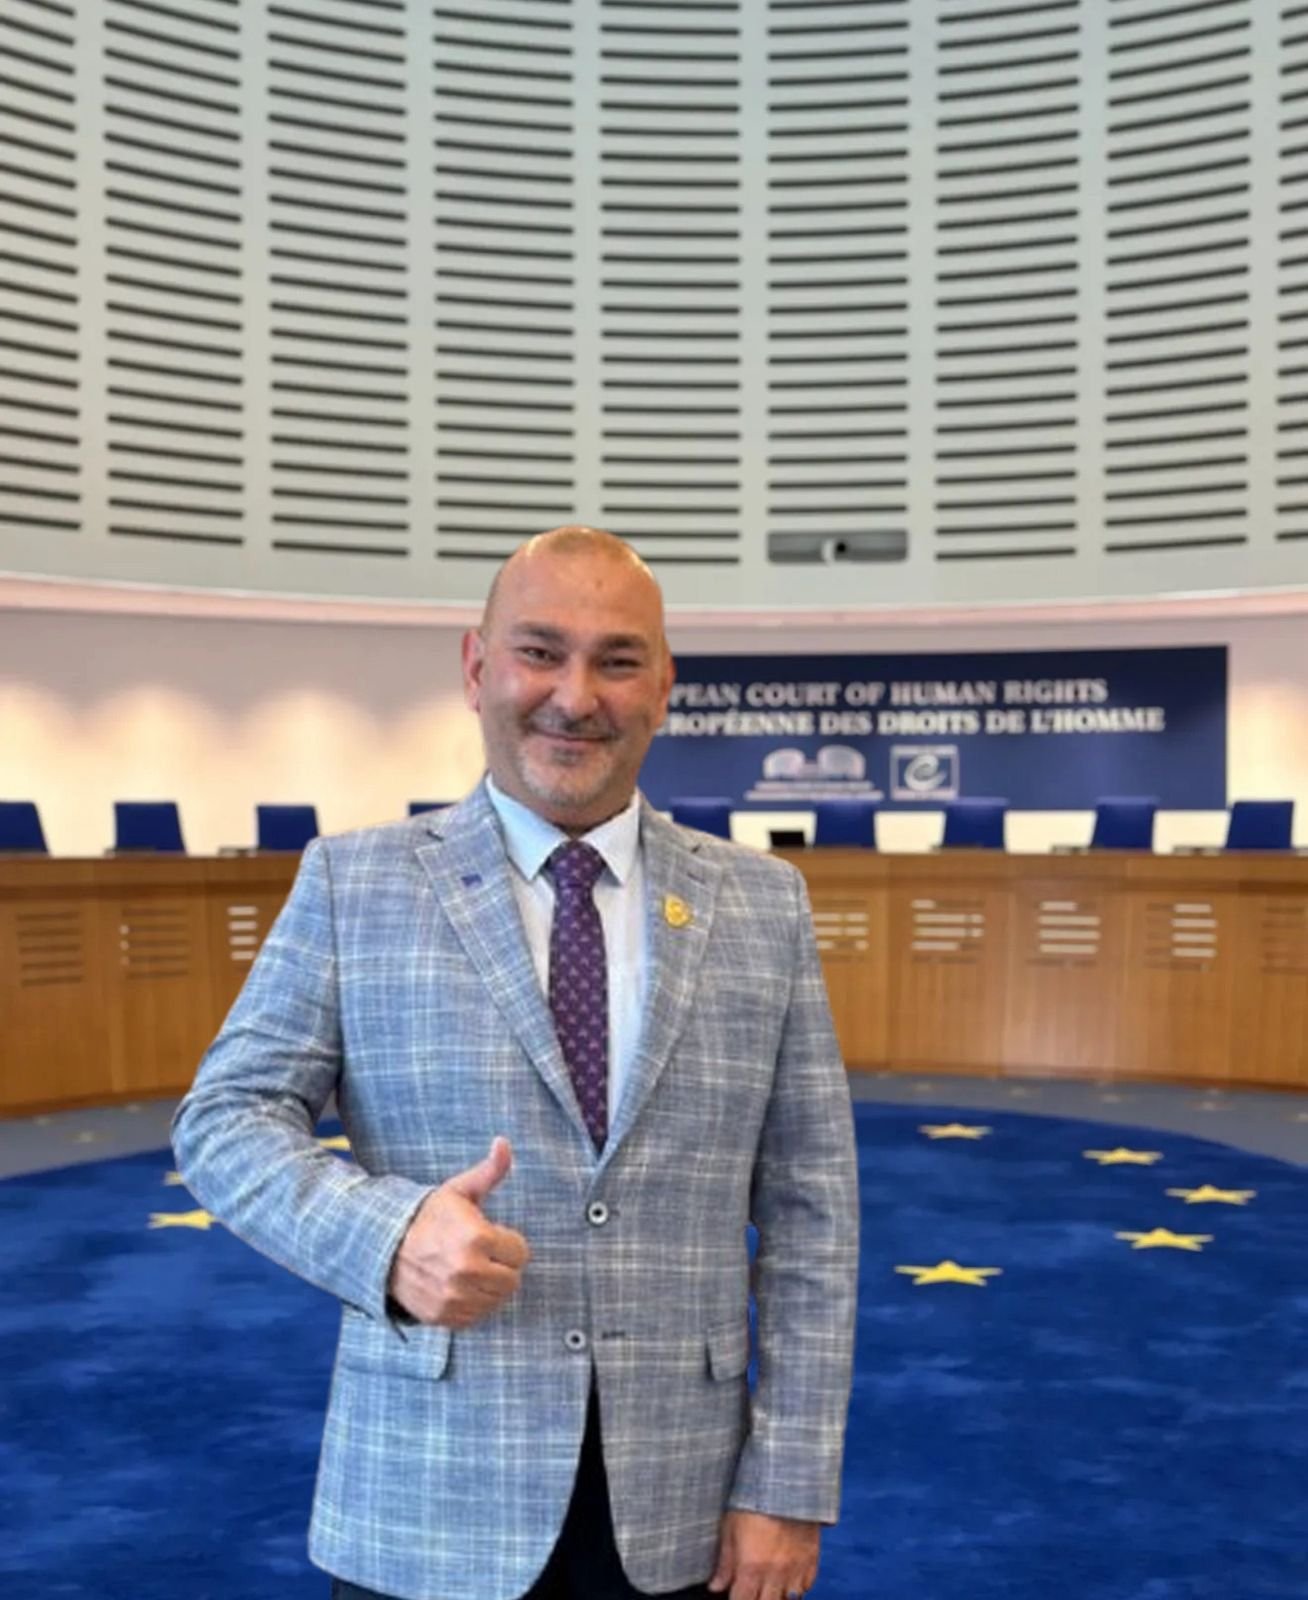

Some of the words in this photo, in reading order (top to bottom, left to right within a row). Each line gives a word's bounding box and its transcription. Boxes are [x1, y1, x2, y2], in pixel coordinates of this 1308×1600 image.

[669, 683, 741, 707] PEAN
[746, 681, 841, 707] COURT
[844, 681, 886, 706] OF
[890, 680, 997, 706] HUMAN
[1003, 678, 1108, 704] RIGHTS
[820, 710, 873, 735] DES
[877, 709, 980, 735] DROITS
[985, 708, 1026, 734] DE
[1031, 706, 1166, 733] L'HOMME
